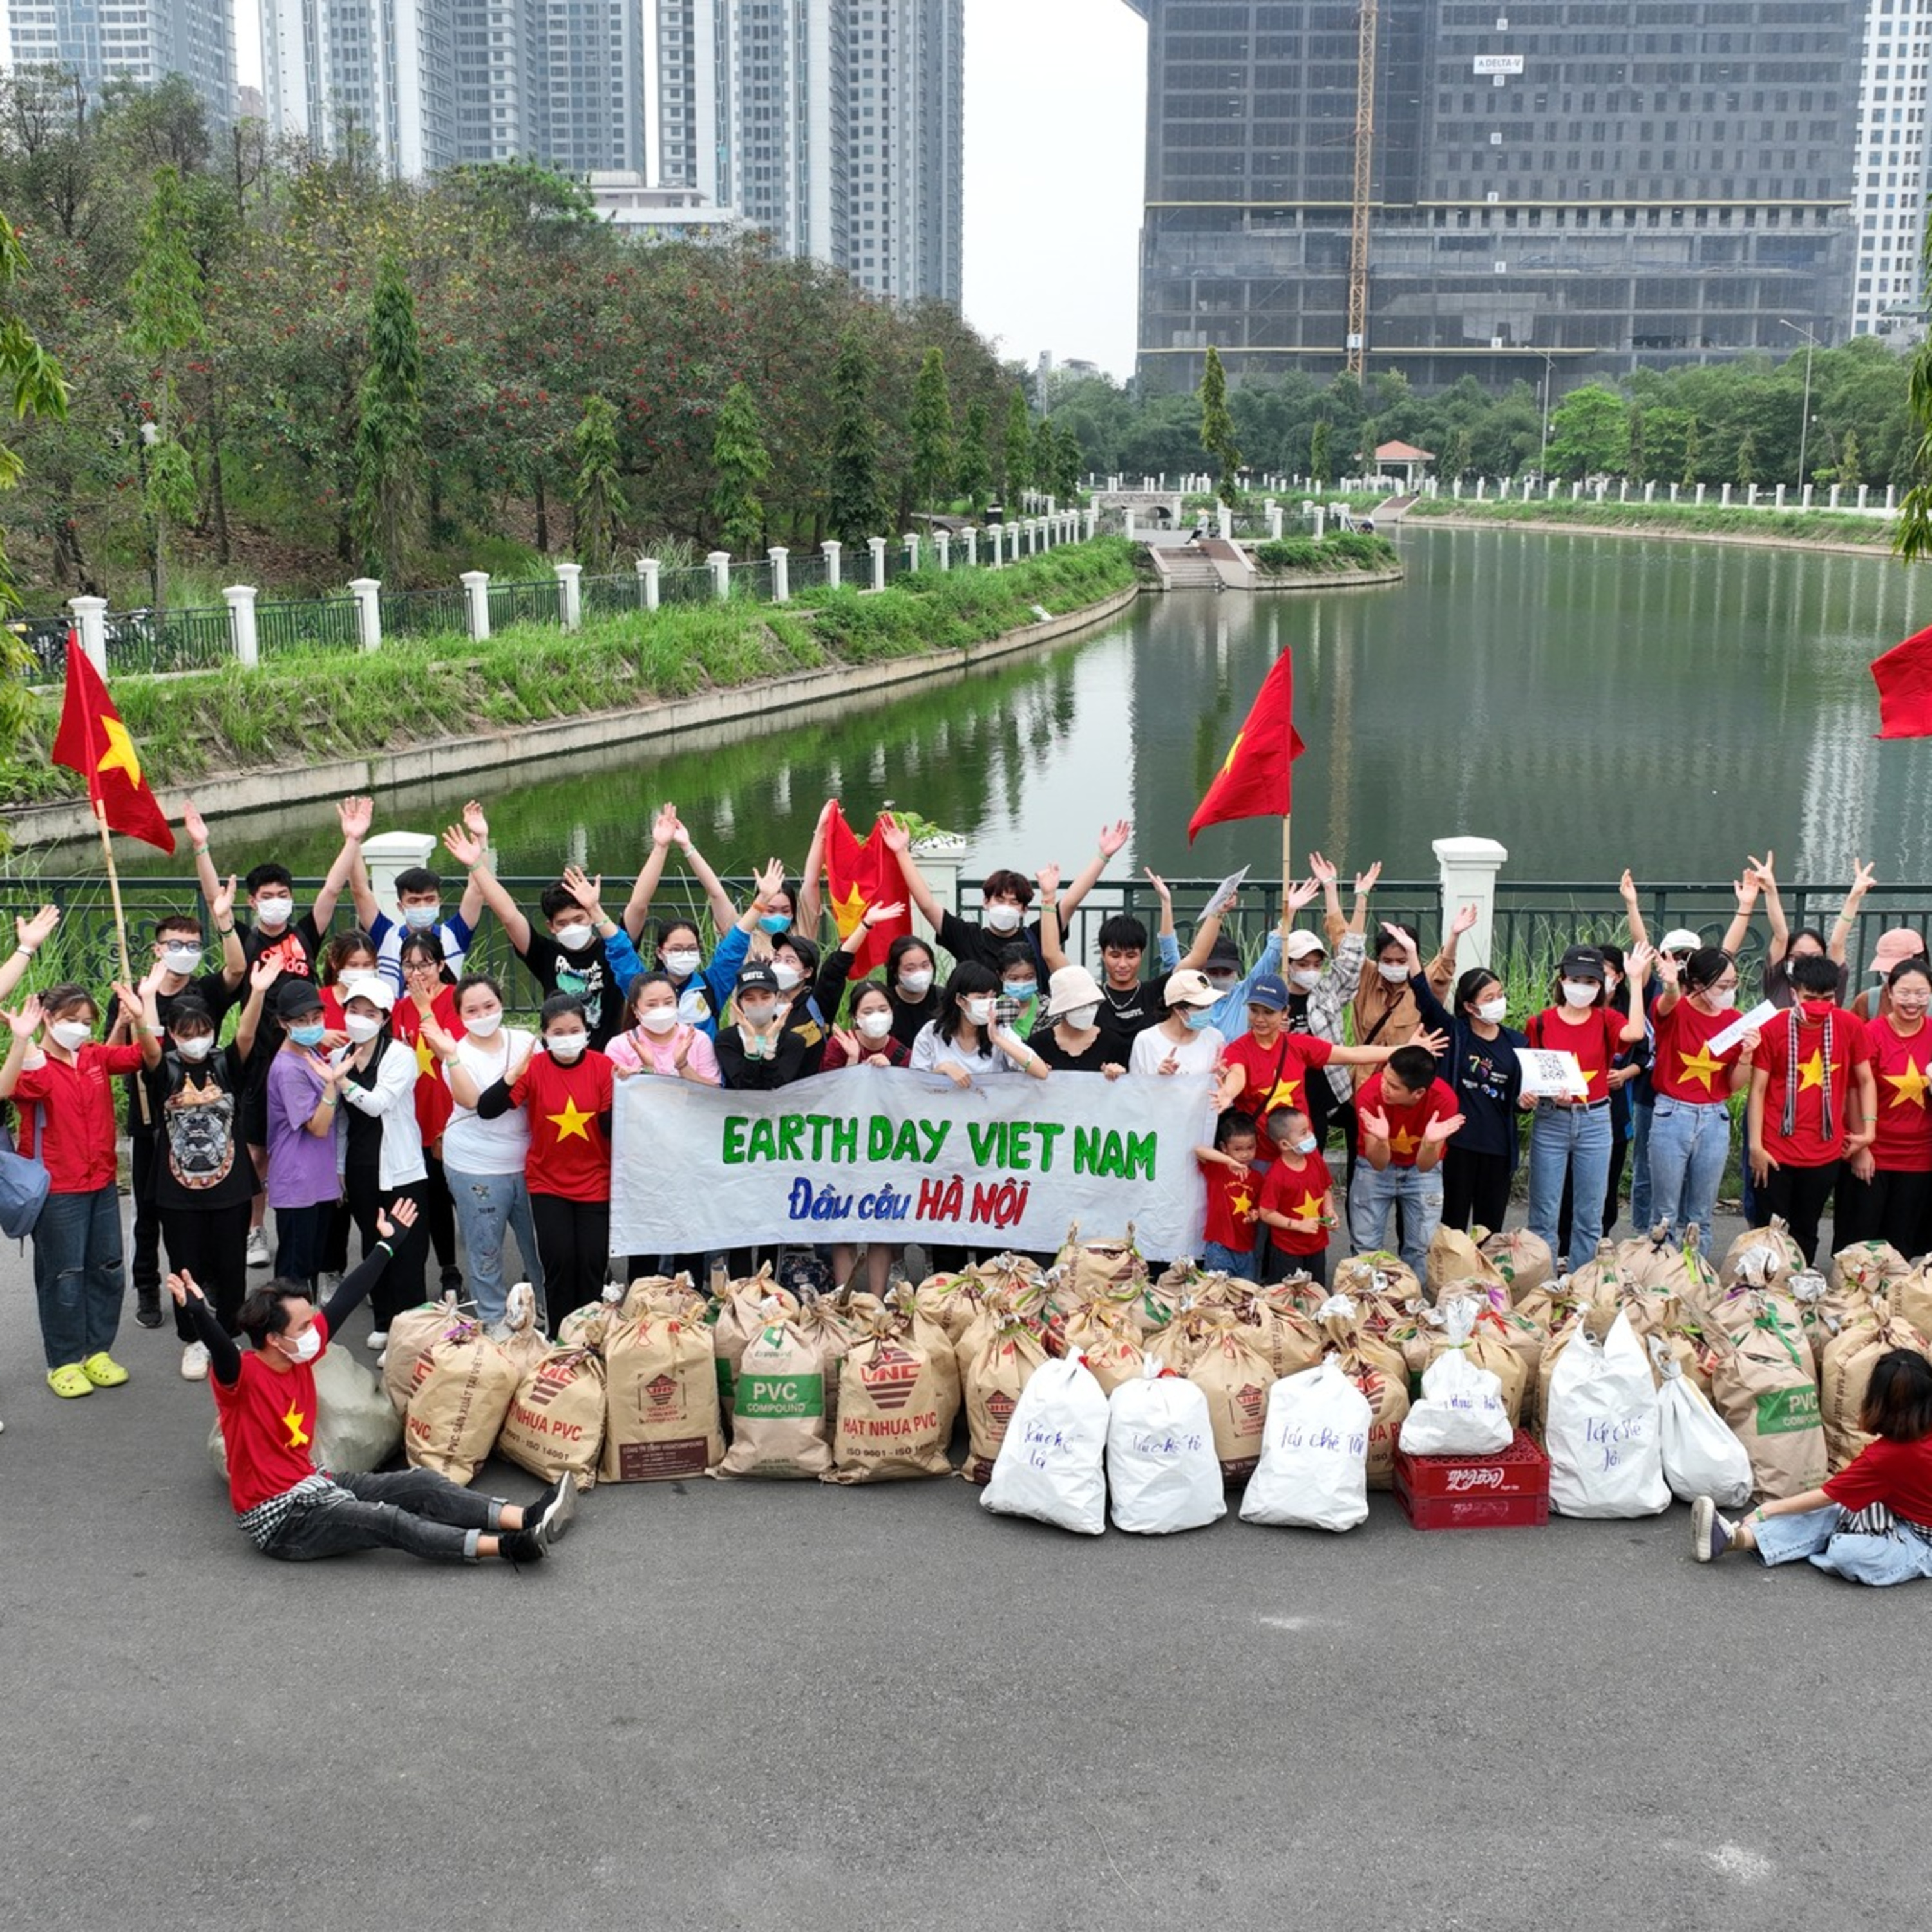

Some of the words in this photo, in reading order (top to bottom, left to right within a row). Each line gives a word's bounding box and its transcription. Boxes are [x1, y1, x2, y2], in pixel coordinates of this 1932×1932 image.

[723, 1115, 858, 1163] EARTH
[867, 1116, 952, 1167] DAY
[967, 1121, 1065, 1173] VIET
[1073, 1126, 1159, 1181] NAM
[789, 1179, 853, 1221] Đầu
[858, 1182, 911, 1221] cầu
[916, 1173, 964, 1222] HÀ
[970, 1179, 1031, 1231] NỘI
[752, 1381, 797, 1401] PVC
[1788, 1391, 1819, 1413] PVC
[746, 1403, 806, 1413] COMPOUND
[551, 1420, 583, 1442] PVC
[843, 1417, 866, 1439] HẠT
[869, 1419, 911, 1440] NHỰA
[913, 1411, 938, 1432] PVC
[847, 1447, 861, 1456] ISO
